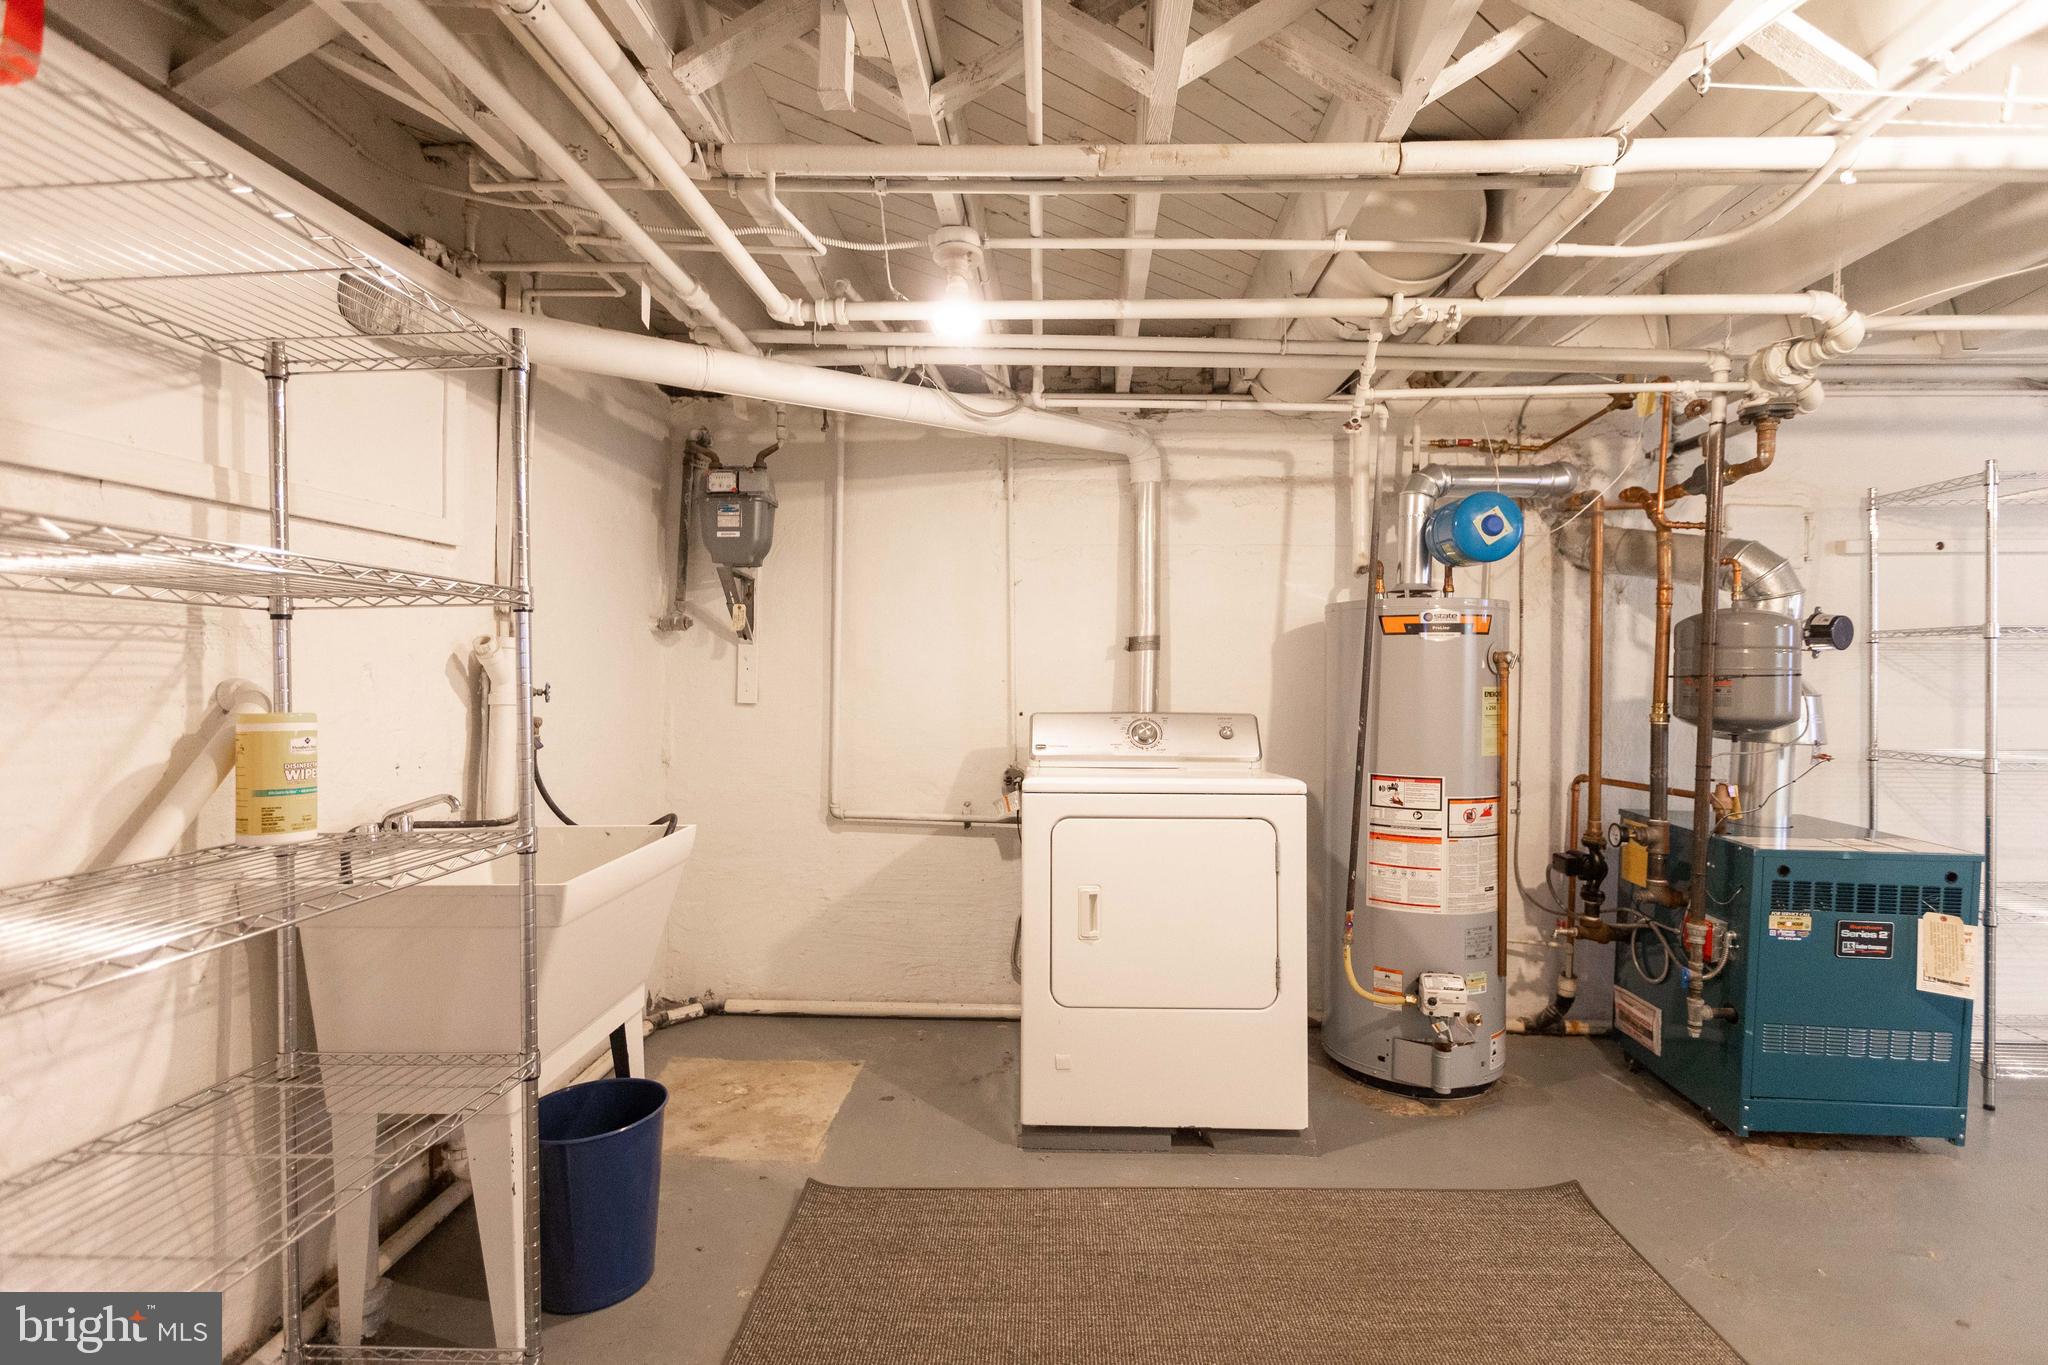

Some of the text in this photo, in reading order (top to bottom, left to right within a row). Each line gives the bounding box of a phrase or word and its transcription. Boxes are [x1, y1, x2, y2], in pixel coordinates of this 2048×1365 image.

[284, 768, 317, 781] WIPE
[1840, 929, 1889, 939] Series 2
